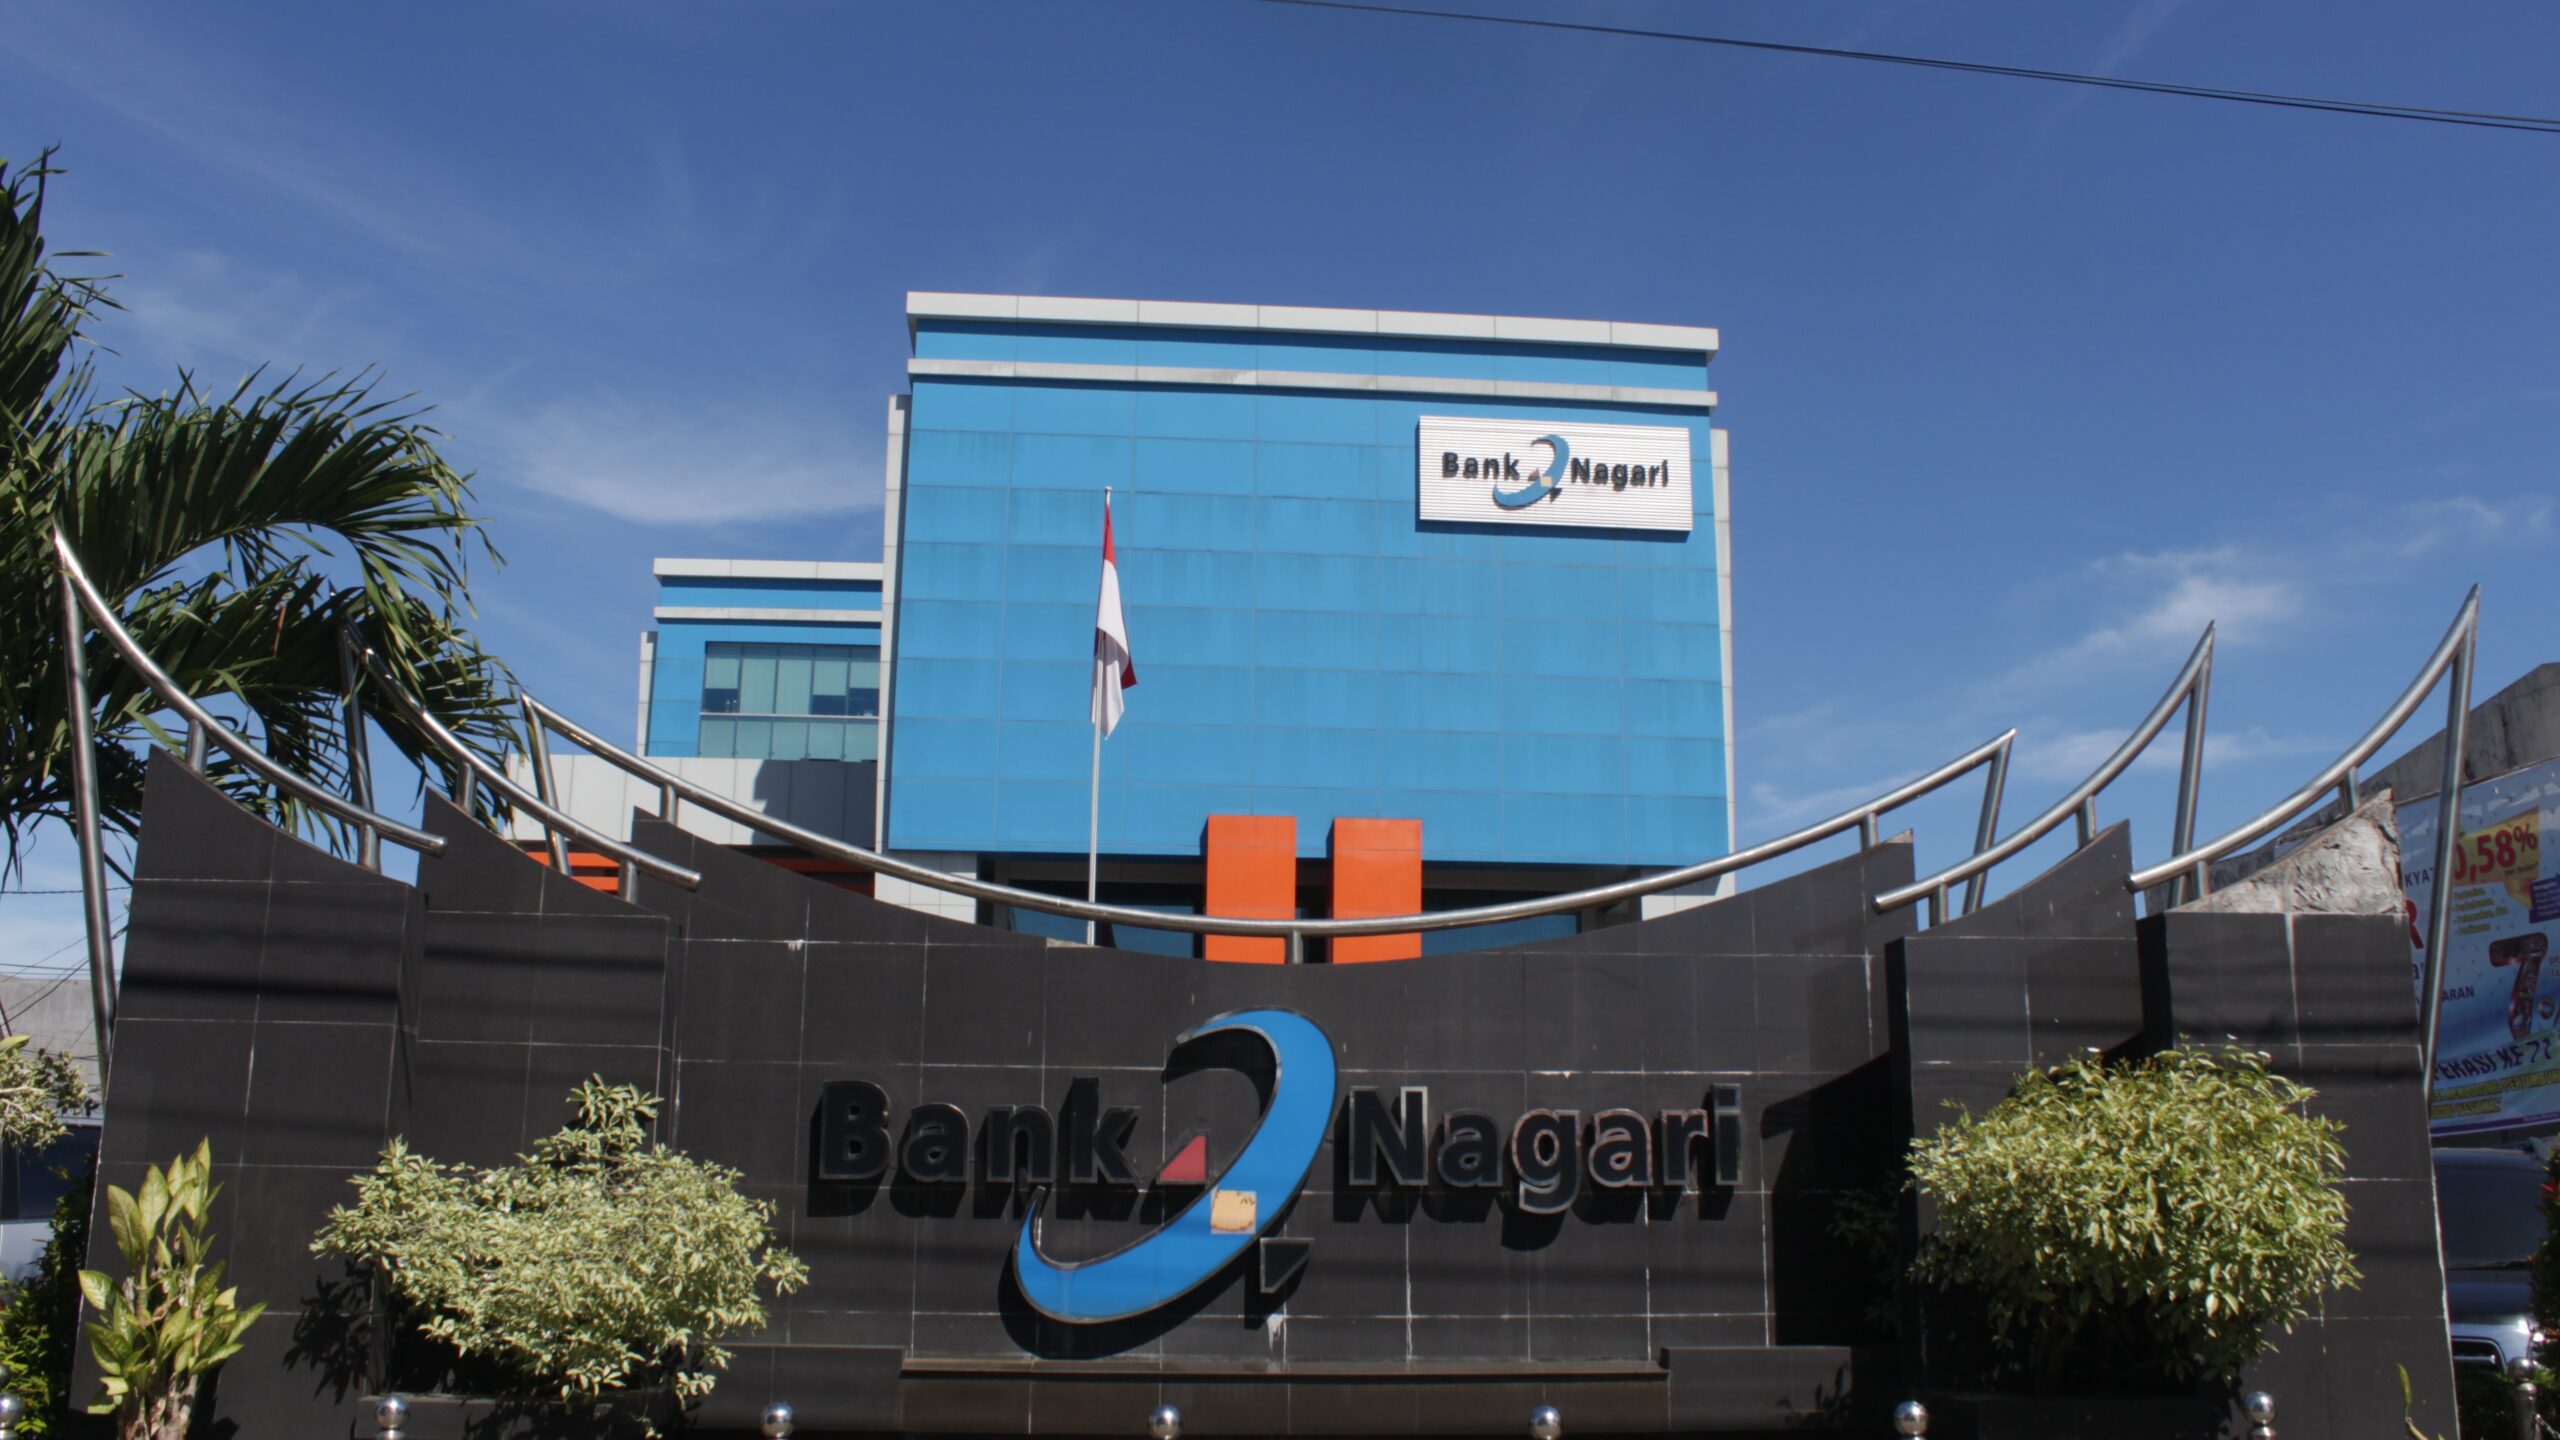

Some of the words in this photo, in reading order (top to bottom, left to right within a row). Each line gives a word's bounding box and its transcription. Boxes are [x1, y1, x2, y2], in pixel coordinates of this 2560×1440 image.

[1441, 451, 1520, 480] Bank
[1570, 457, 1669, 491] Nagari
[2404, 867, 2434, 887] KYA
[818, 1077, 1143, 1184] Bank
[1348, 1083, 1743, 1215] Nagari
